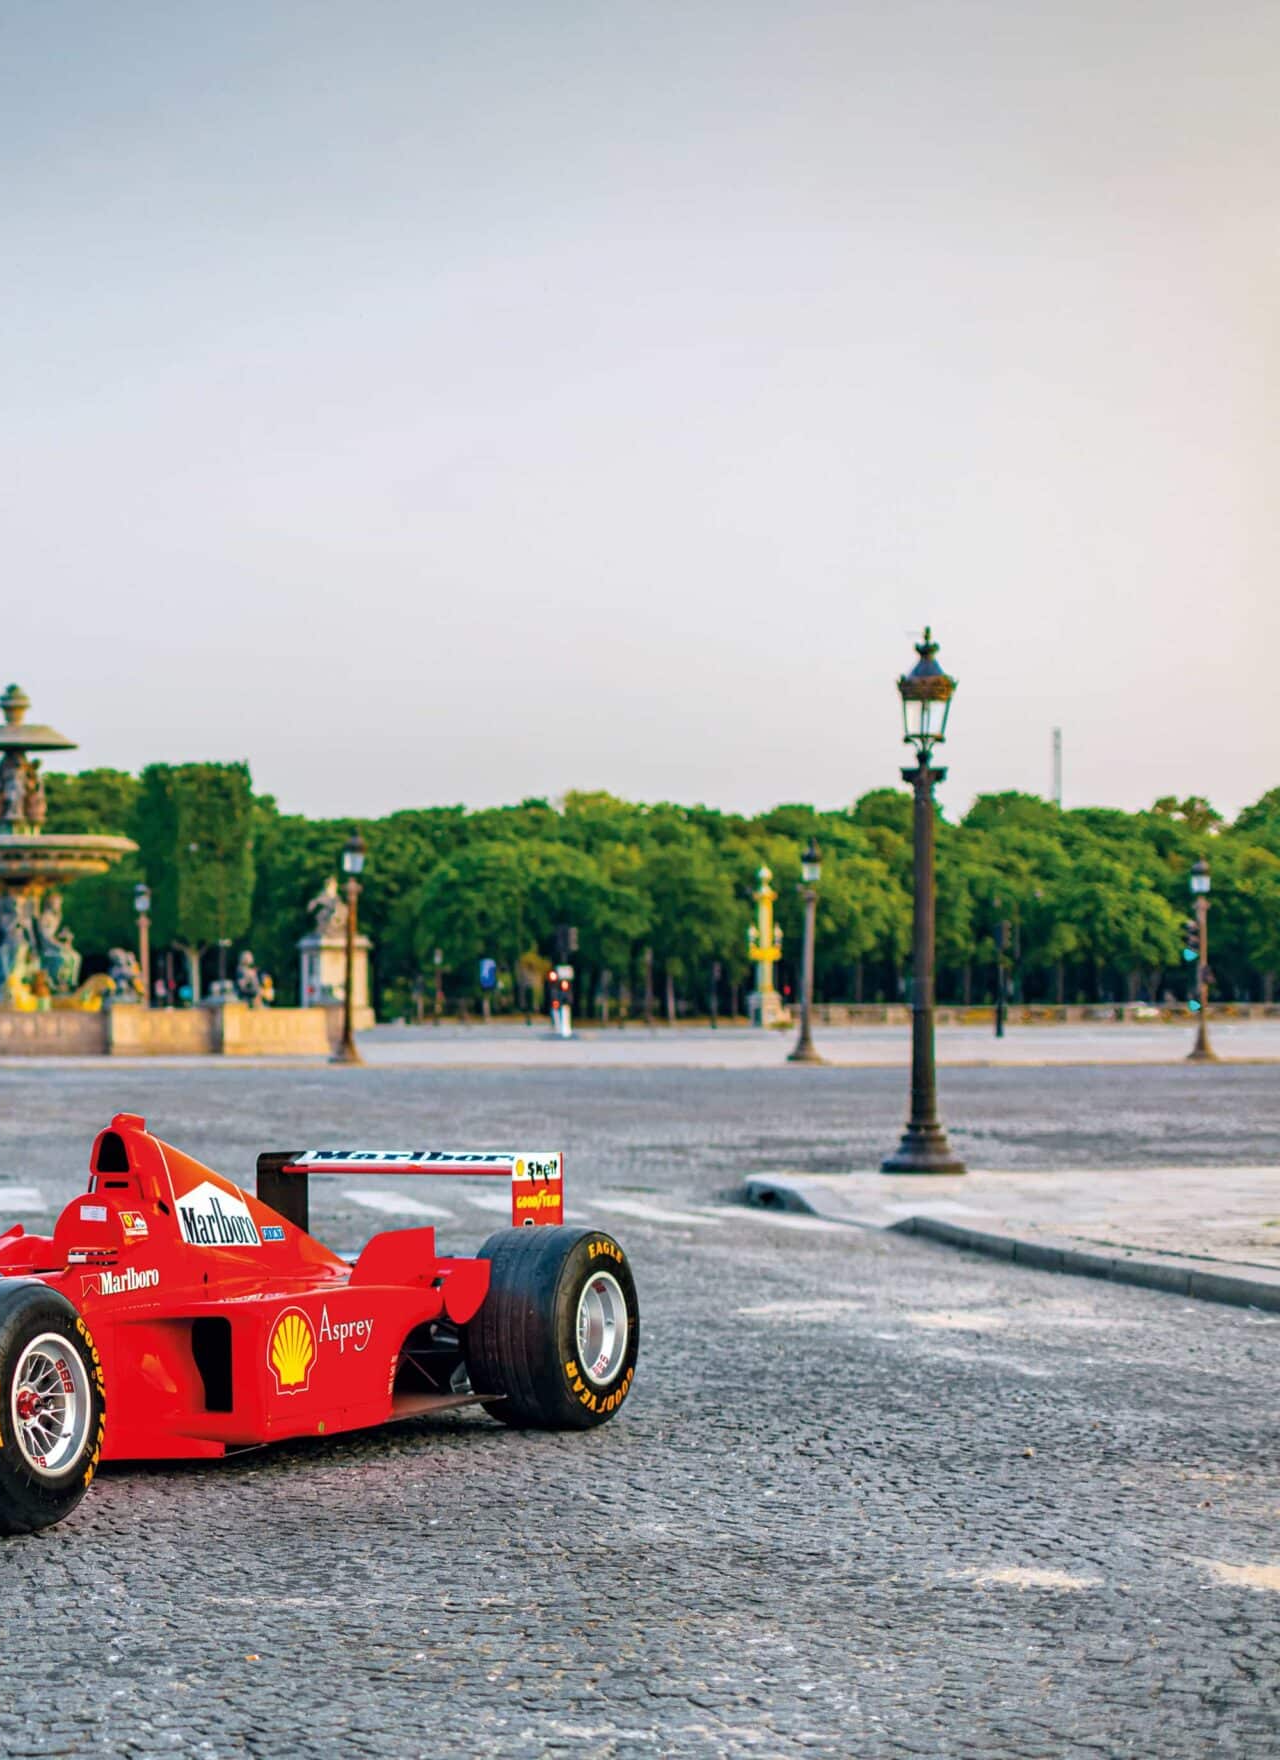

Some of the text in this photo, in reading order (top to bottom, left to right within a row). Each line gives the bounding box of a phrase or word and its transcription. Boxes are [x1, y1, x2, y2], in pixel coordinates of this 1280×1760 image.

[180, 1197, 258, 1244] Marlboro
[588, 1241, 624, 1264] EAGLE
[99, 1267, 160, 1295] Marlboro
[319, 1304, 374, 1353] Asprey
